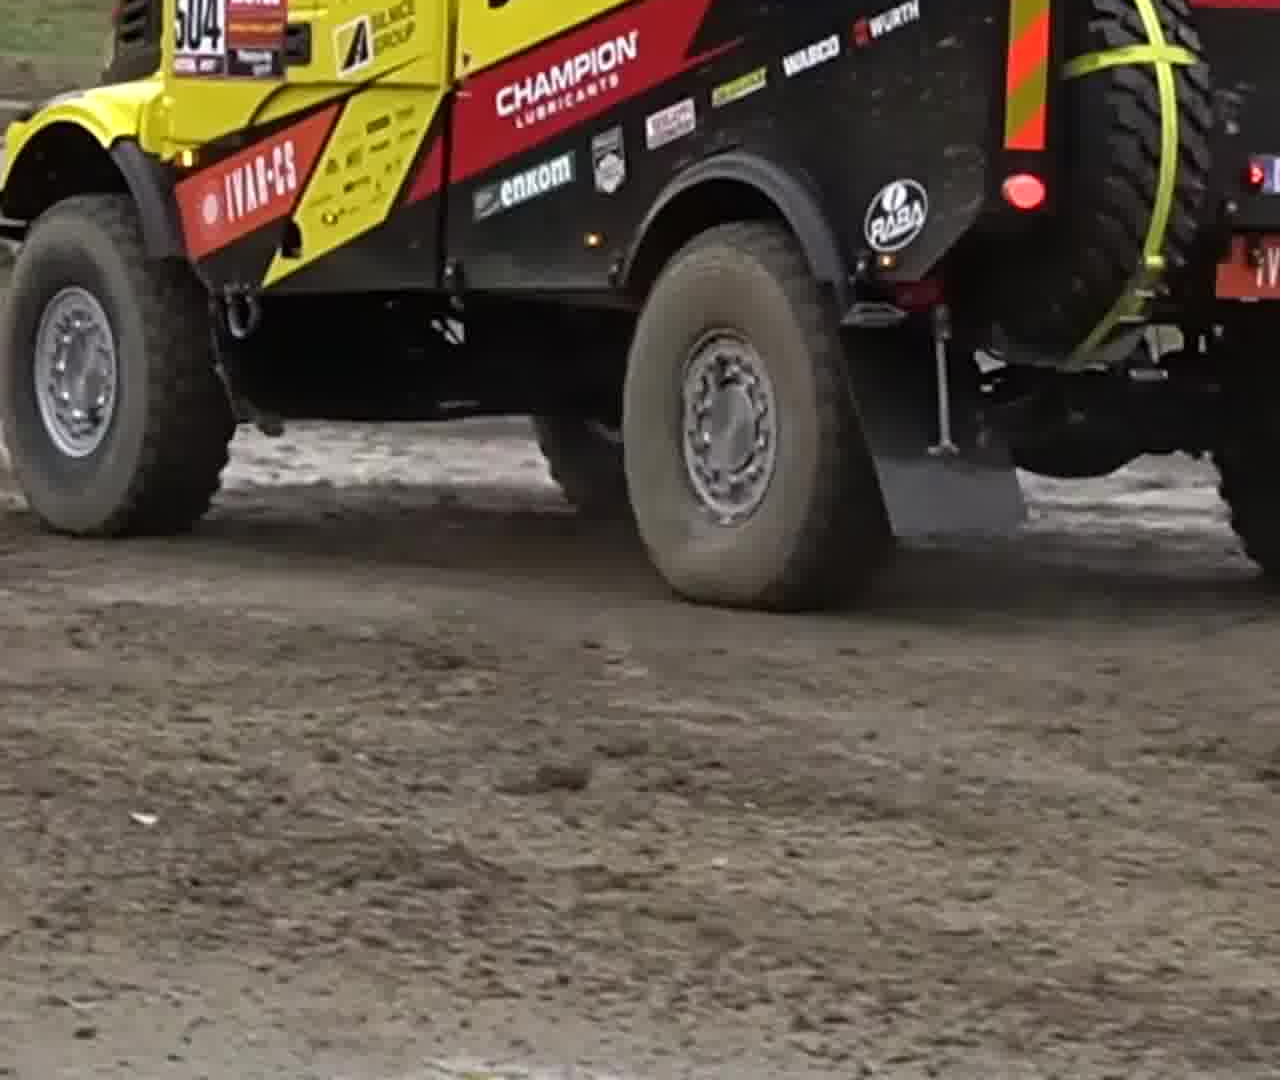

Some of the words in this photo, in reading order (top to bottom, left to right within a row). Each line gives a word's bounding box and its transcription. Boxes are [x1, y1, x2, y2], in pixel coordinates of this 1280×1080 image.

[495, 28, 639, 118] CHAMPION
[782, 34, 841, 78] WABCO
[514, 73, 620, 129] LUBRICANTS
[499, 153, 572, 207] enkom
